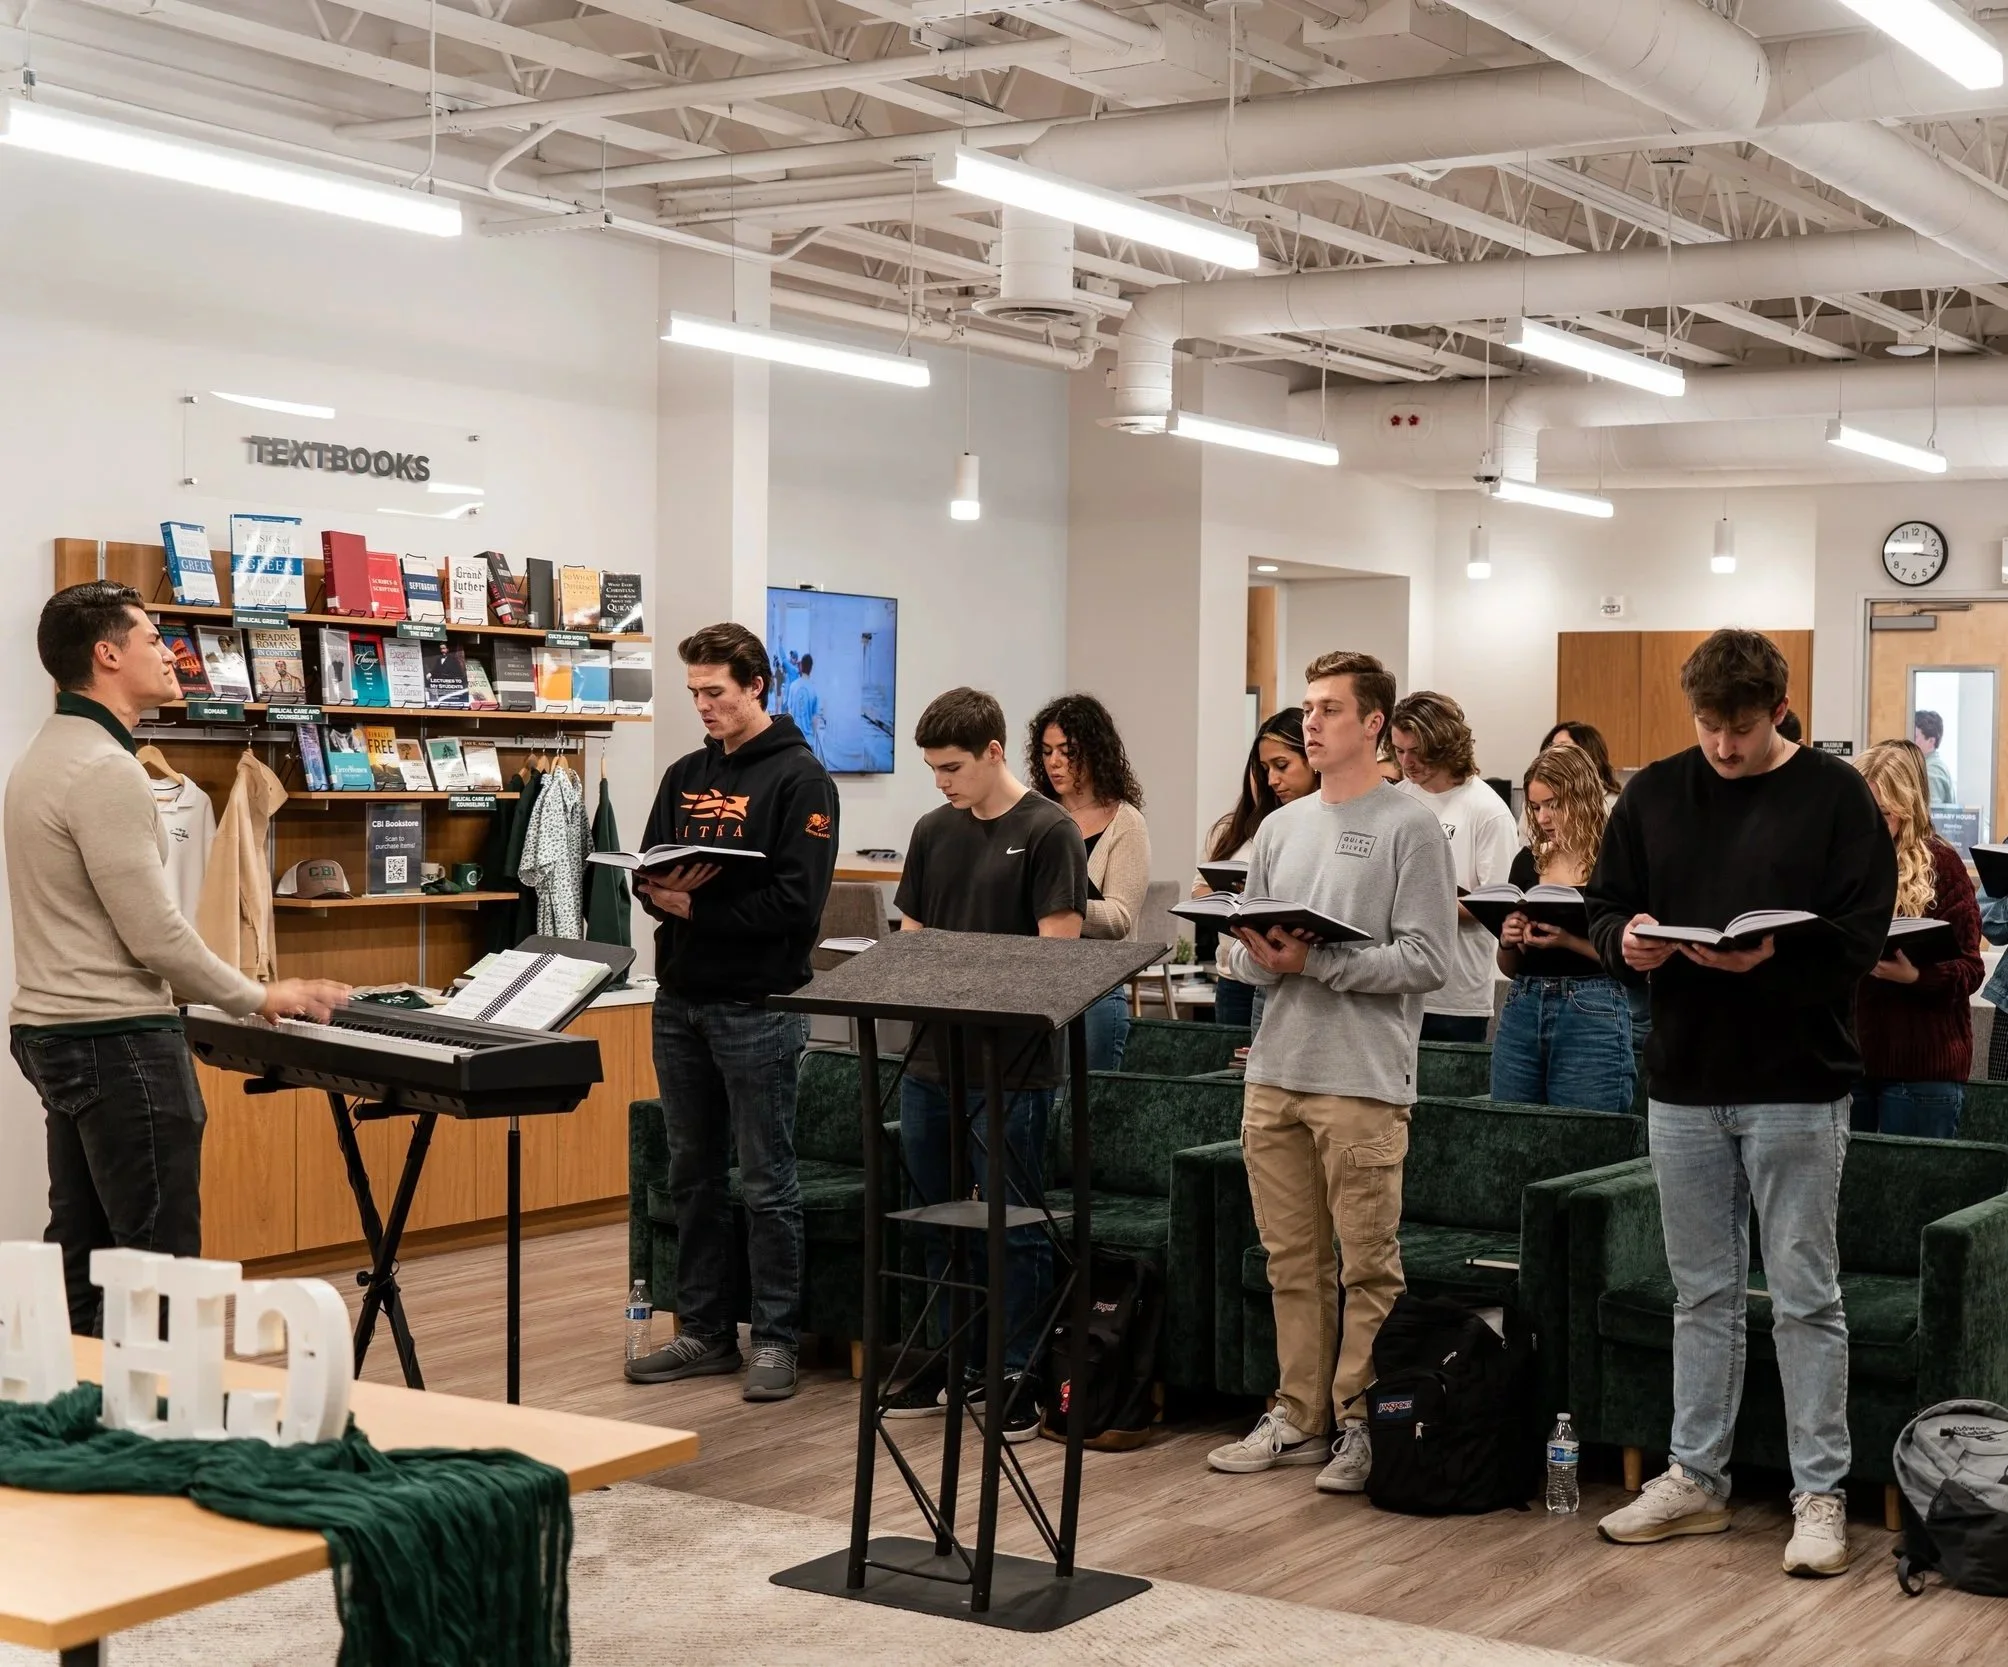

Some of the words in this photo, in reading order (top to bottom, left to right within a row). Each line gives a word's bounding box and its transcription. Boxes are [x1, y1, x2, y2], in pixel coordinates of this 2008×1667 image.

[249, 435, 430, 482] TEXTBOOKS
[1902, 531, 1908, 539] 11
[1912, 528, 1920, 536] 12
[1925, 530, 1927, 538] 1
[1934, 549, 1939, 557] 3
[180, 559, 214, 572] GREEK
[1894, 561, 1899, 569] 8
[1902, 568, 1907, 576] 7
[1922, 569, 1927, 577] 5
[409, 582, 438, 592] SEPTUAGINT
[453, 580, 485, 594] Luther
[255, 633, 296, 641] READING
[256, 641, 298, 650] ROMANS
[368, 739, 394, 754] FREE
[1341, 844, 1368, 853] SILVER
[309, 866, 336, 878] CBI
